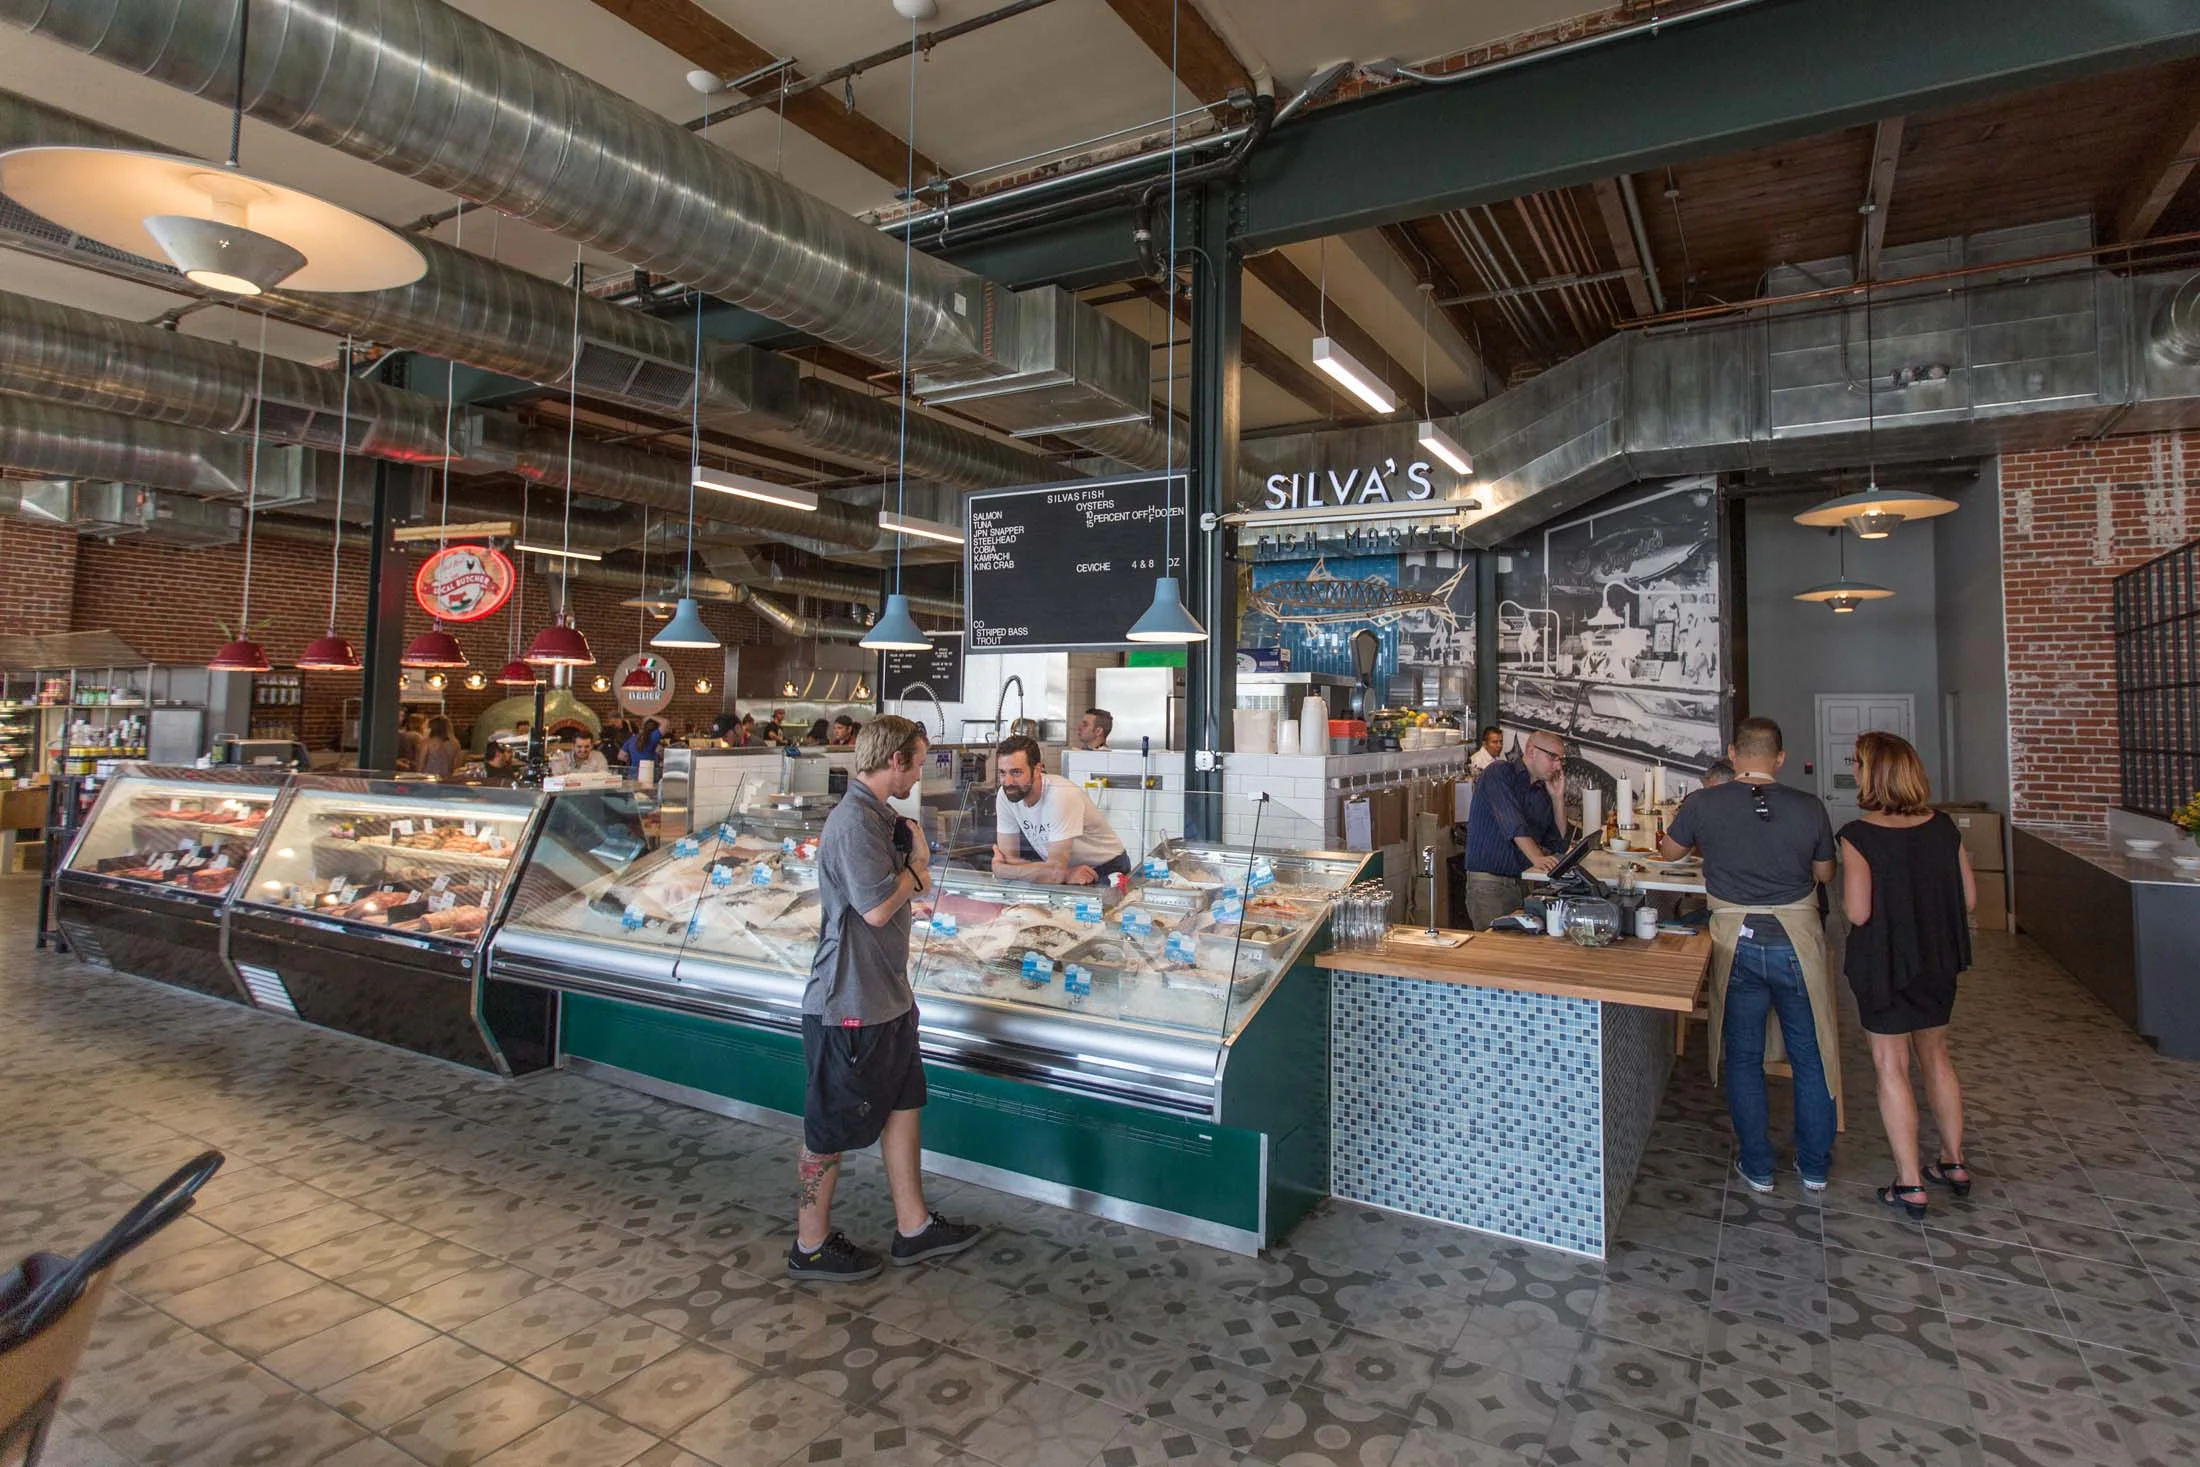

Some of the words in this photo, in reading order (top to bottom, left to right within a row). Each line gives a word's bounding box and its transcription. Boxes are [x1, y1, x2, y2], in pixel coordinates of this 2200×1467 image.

[1264, 458, 1433, 510] SILVA'S
[1047, 492, 1080, 504] SILVAS
[1082, 490, 1105, 500] FISH
[1075, 500, 1115, 511] OYSTERS
[973, 511, 1002, 521] SALMON
[1085, 511, 1094, 519] 10
[1093, 511, 1130, 523] PERCENT
[1131, 510, 1148, 520] OFF
[973, 521, 992, 530] TUNA
[1086, 520, 1094, 528] 15
[973, 529, 988, 538] JPN
[990, 526, 1025, 537] SNAPPER
[973, 535, 1017, 546] STEELHEAD
[1258, 531, 1317, 554] FISH
[1345, 524, 1461, 549] MARKET
[973, 545, 996, 554] COBIA
[974, 552, 1010, 562] KAMPACHI
[974, 562, 992, 571] KING
[993, 560, 1015, 570] CRAB
[1076, 562, 1111, 573] CEVICHE
[1131, 560, 1137, 569] 4
[1140, 560, 1146, 569] &
[1148, 559, 1154, 568] 8
[433, 583, 455, 594] LCAL
[456, 575, 490, 587] BUTCHER
[973, 620, 985, 629] CO
[976, 628, 1007, 637] STRIPED
[1008, 627, 1028, 636] BASS
[976, 636, 1002, 645] TROUT
